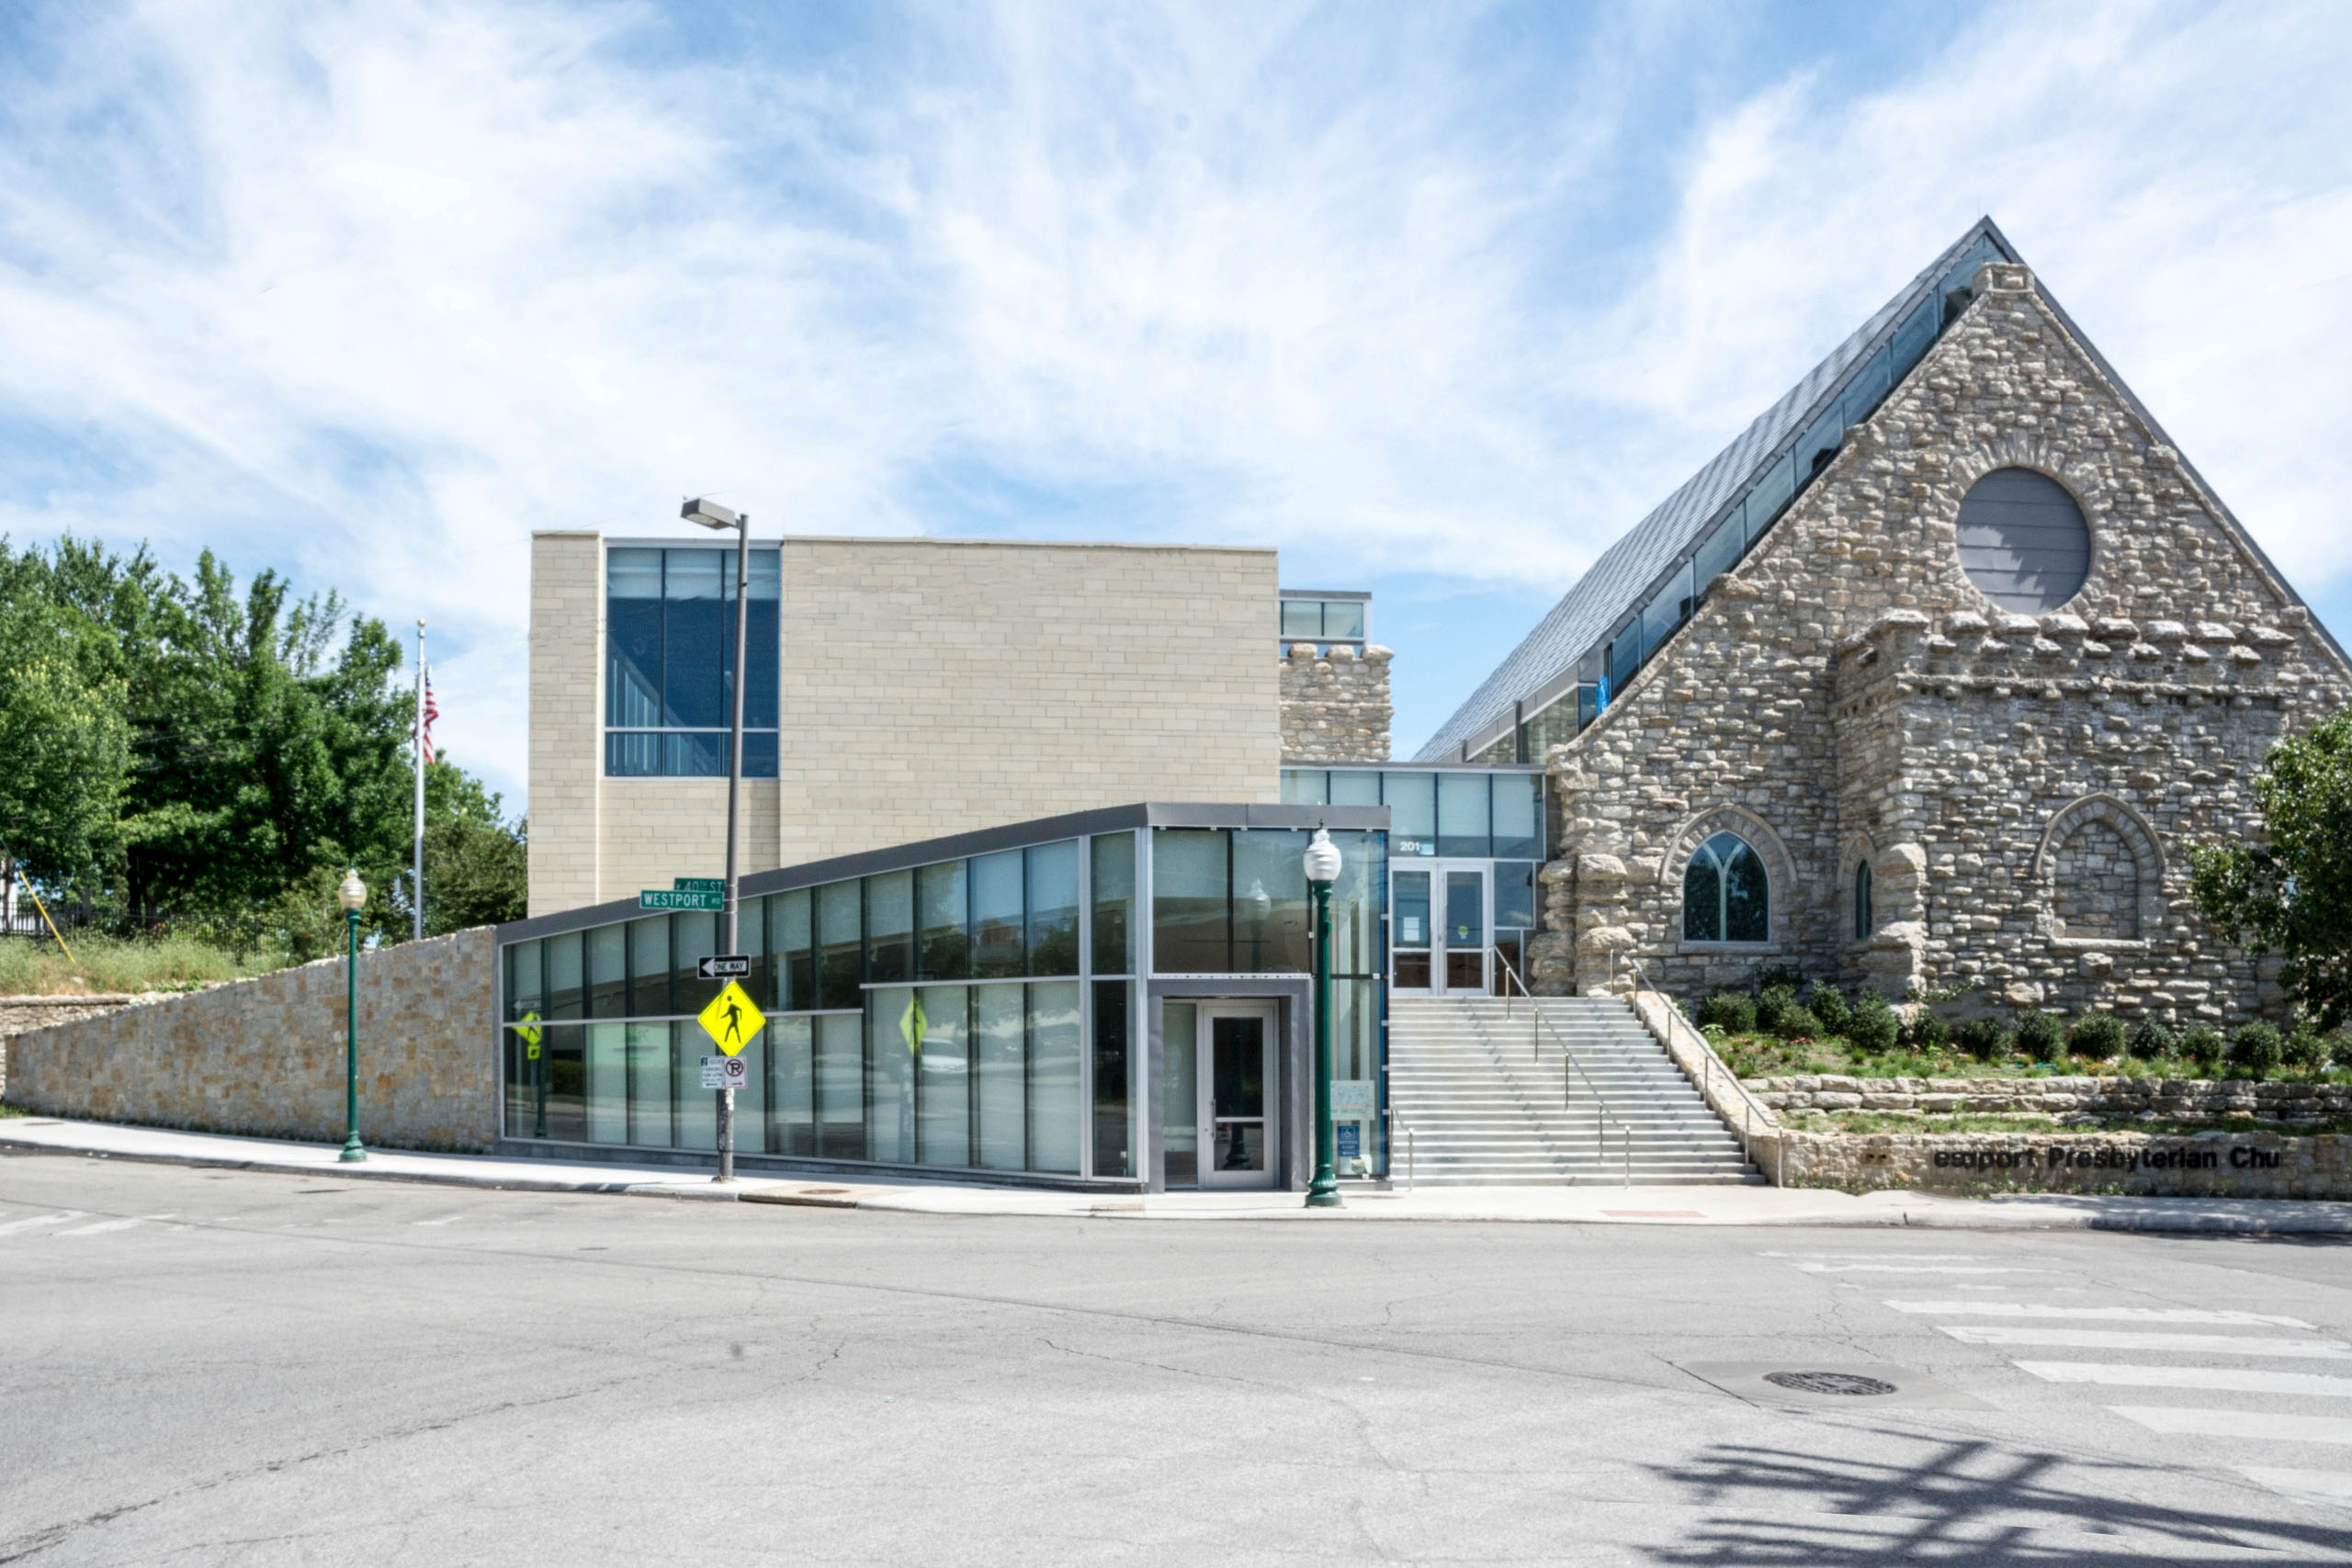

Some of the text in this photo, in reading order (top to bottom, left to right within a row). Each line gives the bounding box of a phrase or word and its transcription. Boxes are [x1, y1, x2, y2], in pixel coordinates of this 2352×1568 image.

[1400, 841, 1419, 852] 201
[710, 882, 723, 892] ST
[643, 893, 707, 908] WESTPORT
[713, 962, 744, 971] ONE WAY
[2049, 1146, 2218, 1173] Presbyterian
[2229, 1145, 2279, 1168] Chu
